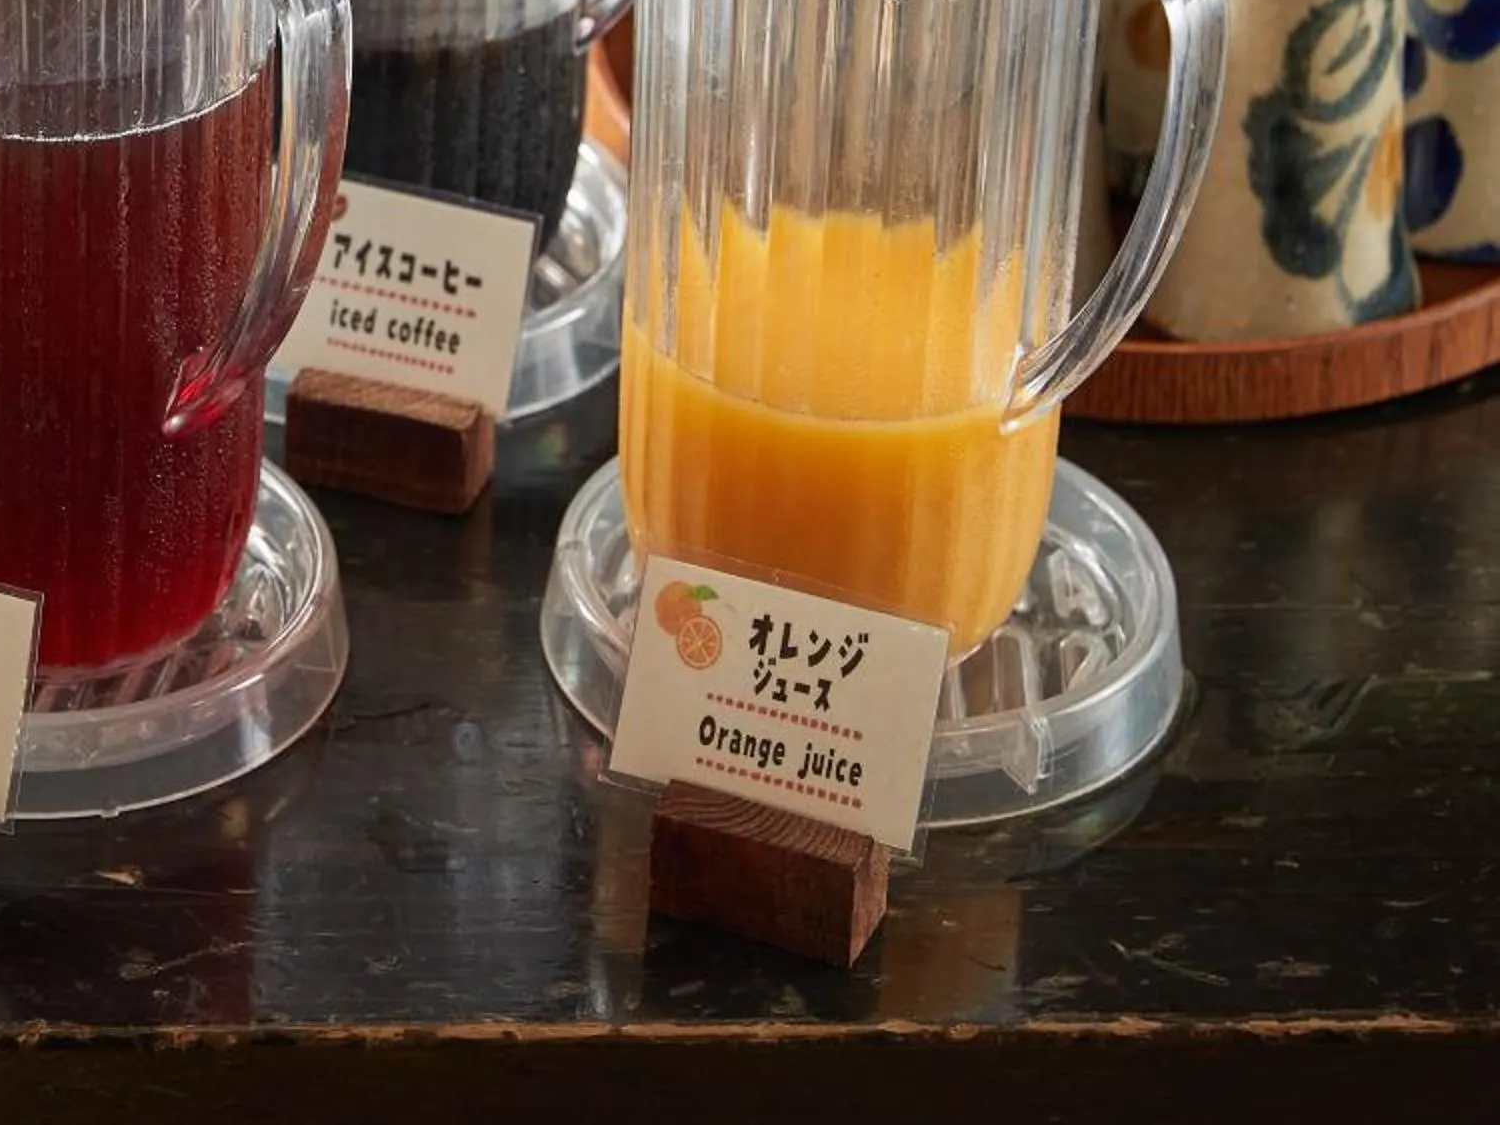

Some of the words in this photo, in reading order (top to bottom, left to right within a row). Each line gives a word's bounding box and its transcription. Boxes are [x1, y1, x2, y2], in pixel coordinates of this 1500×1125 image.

[334, 233, 482, 295] アイスコーヒー
[330, 299, 377, 335] iced
[387, 317, 461, 355] coffee
[748, 614, 870, 678] オレンジ
[752, 657, 833, 712] ジュース
[698, 715, 786, 769] Orange
[797, 742, 864, 787] juice
